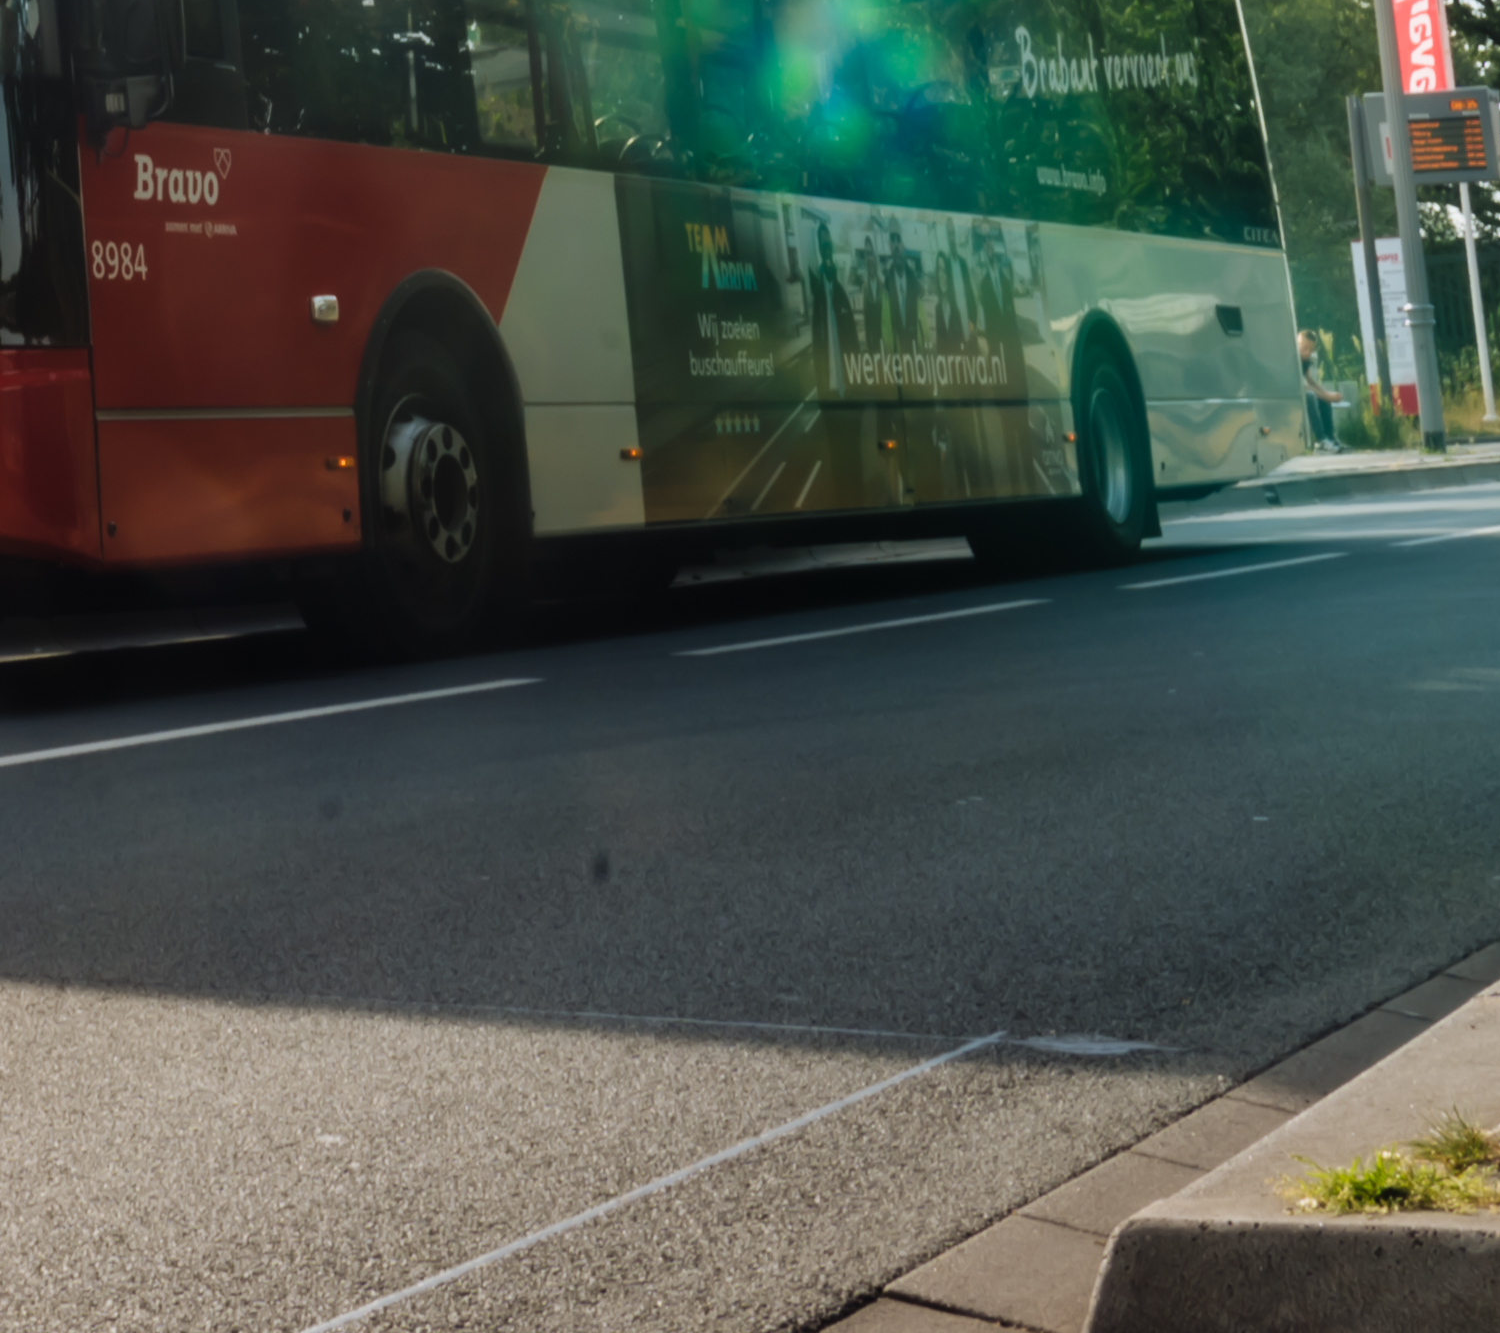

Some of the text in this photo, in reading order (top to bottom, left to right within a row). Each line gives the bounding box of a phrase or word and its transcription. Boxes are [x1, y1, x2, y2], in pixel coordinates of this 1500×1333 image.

[1015, 26, 1098, 99] Brabant
[134, 153, 219, 206] Bravo
[92, 240, 148, 280] 8984
[697, 312, 760, 345] Wij zoeken
[689, 349, 775, 377] buschauffeurs!
[843, 338, 1008, 397] werkenbijarriva.nl
